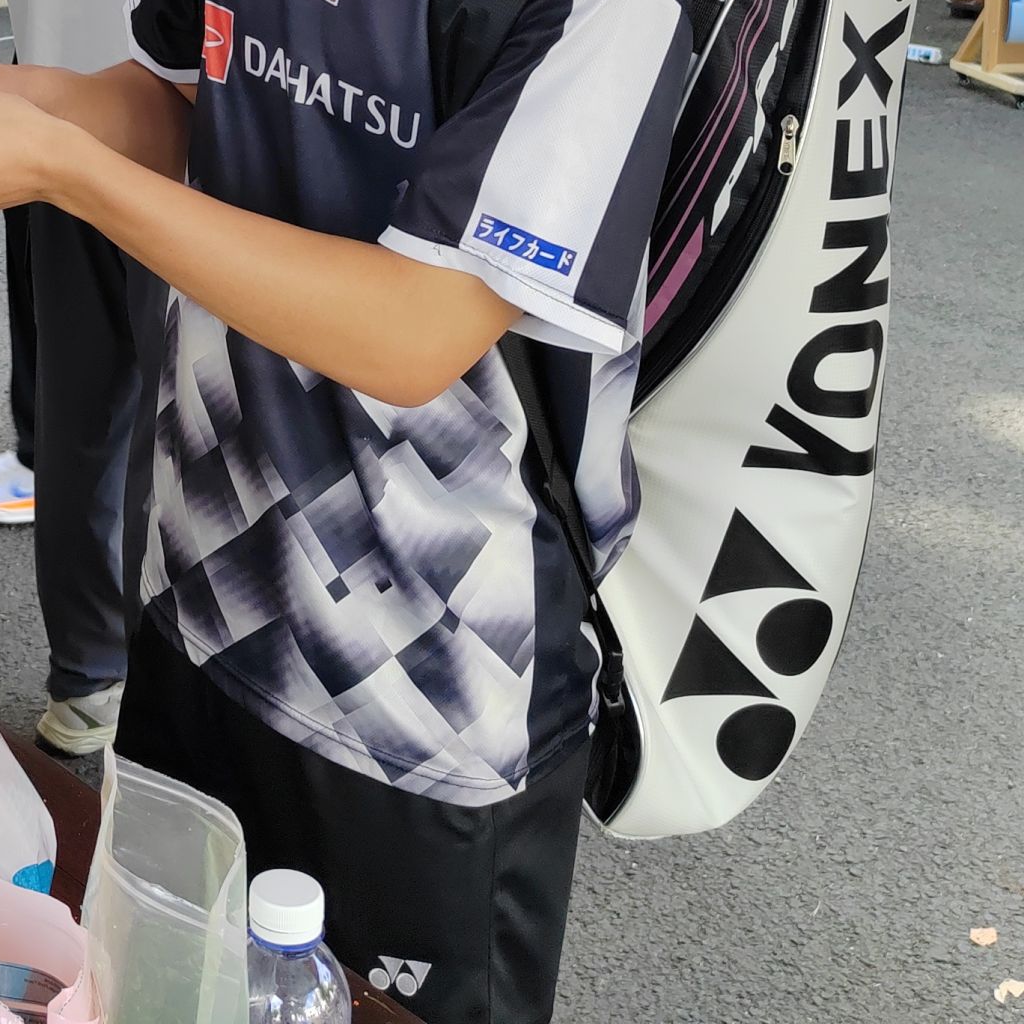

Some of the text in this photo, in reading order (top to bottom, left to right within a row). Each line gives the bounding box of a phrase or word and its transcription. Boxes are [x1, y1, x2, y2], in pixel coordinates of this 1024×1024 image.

[478, 218, 574, 269] ライフカード
[740, 3, 911, 476] YONEX
